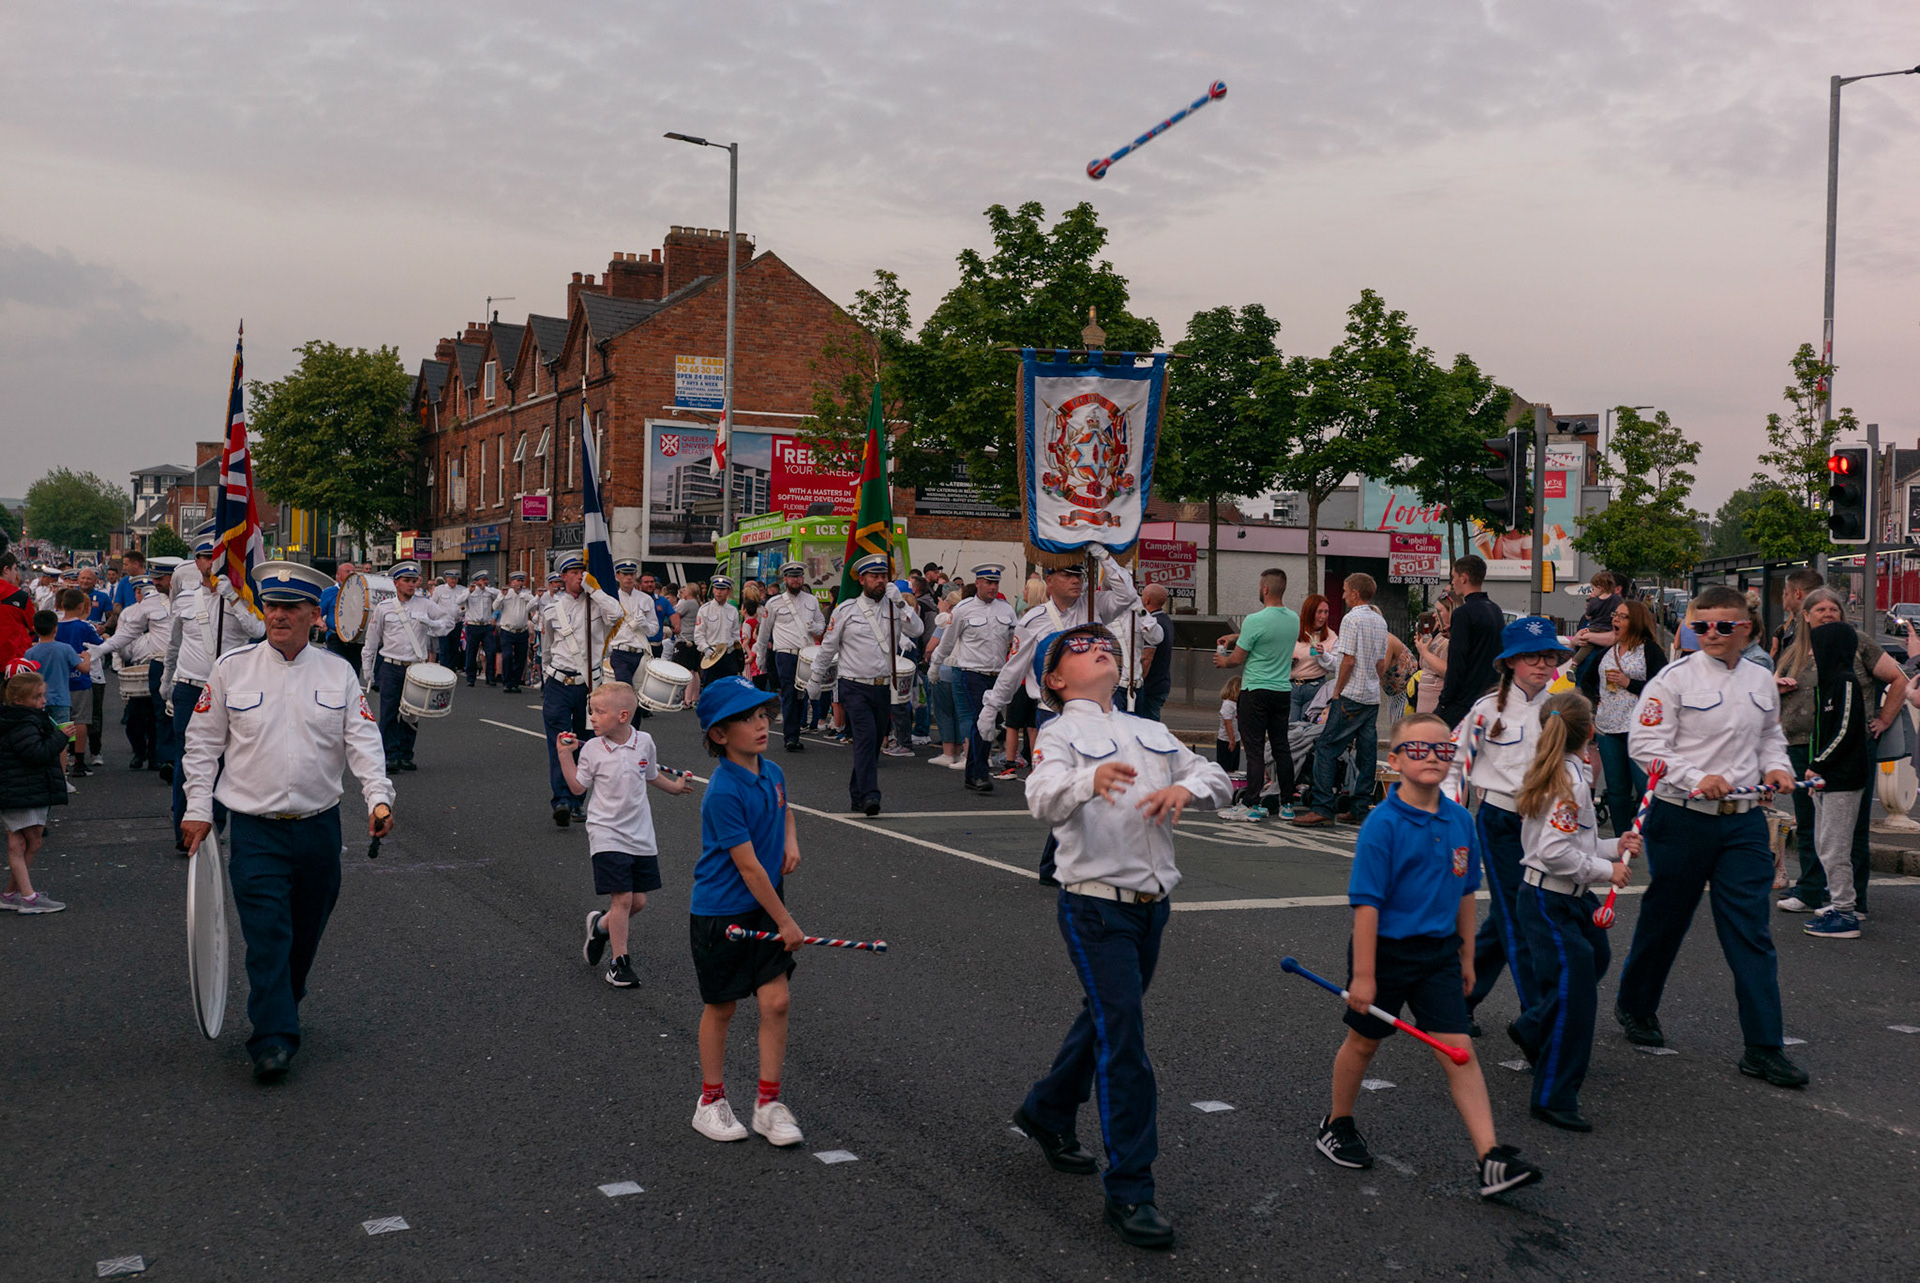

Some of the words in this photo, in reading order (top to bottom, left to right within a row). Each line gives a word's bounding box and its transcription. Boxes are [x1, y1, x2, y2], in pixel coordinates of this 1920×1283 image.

[713, 367, 724, 375] 30
[785, 465, 813, 475] YOUR
[816, 525, 837, 535] ICE
[1145, 541, 1182, 551] Campbell
[1415, 544, 1437, 552] Cairns
[1168, 551, 1192, 560] Cairns
[1399, 560, 1430, 574] SOLD
[1150, 567, 1186, 583] SOLD
[1390, 576, 1402, 584] 028
[1404, 577, 1420, 585] 9024
[1422, 577, 1439, 585] 9024
[1176, 588, 1195, 597] 9024
